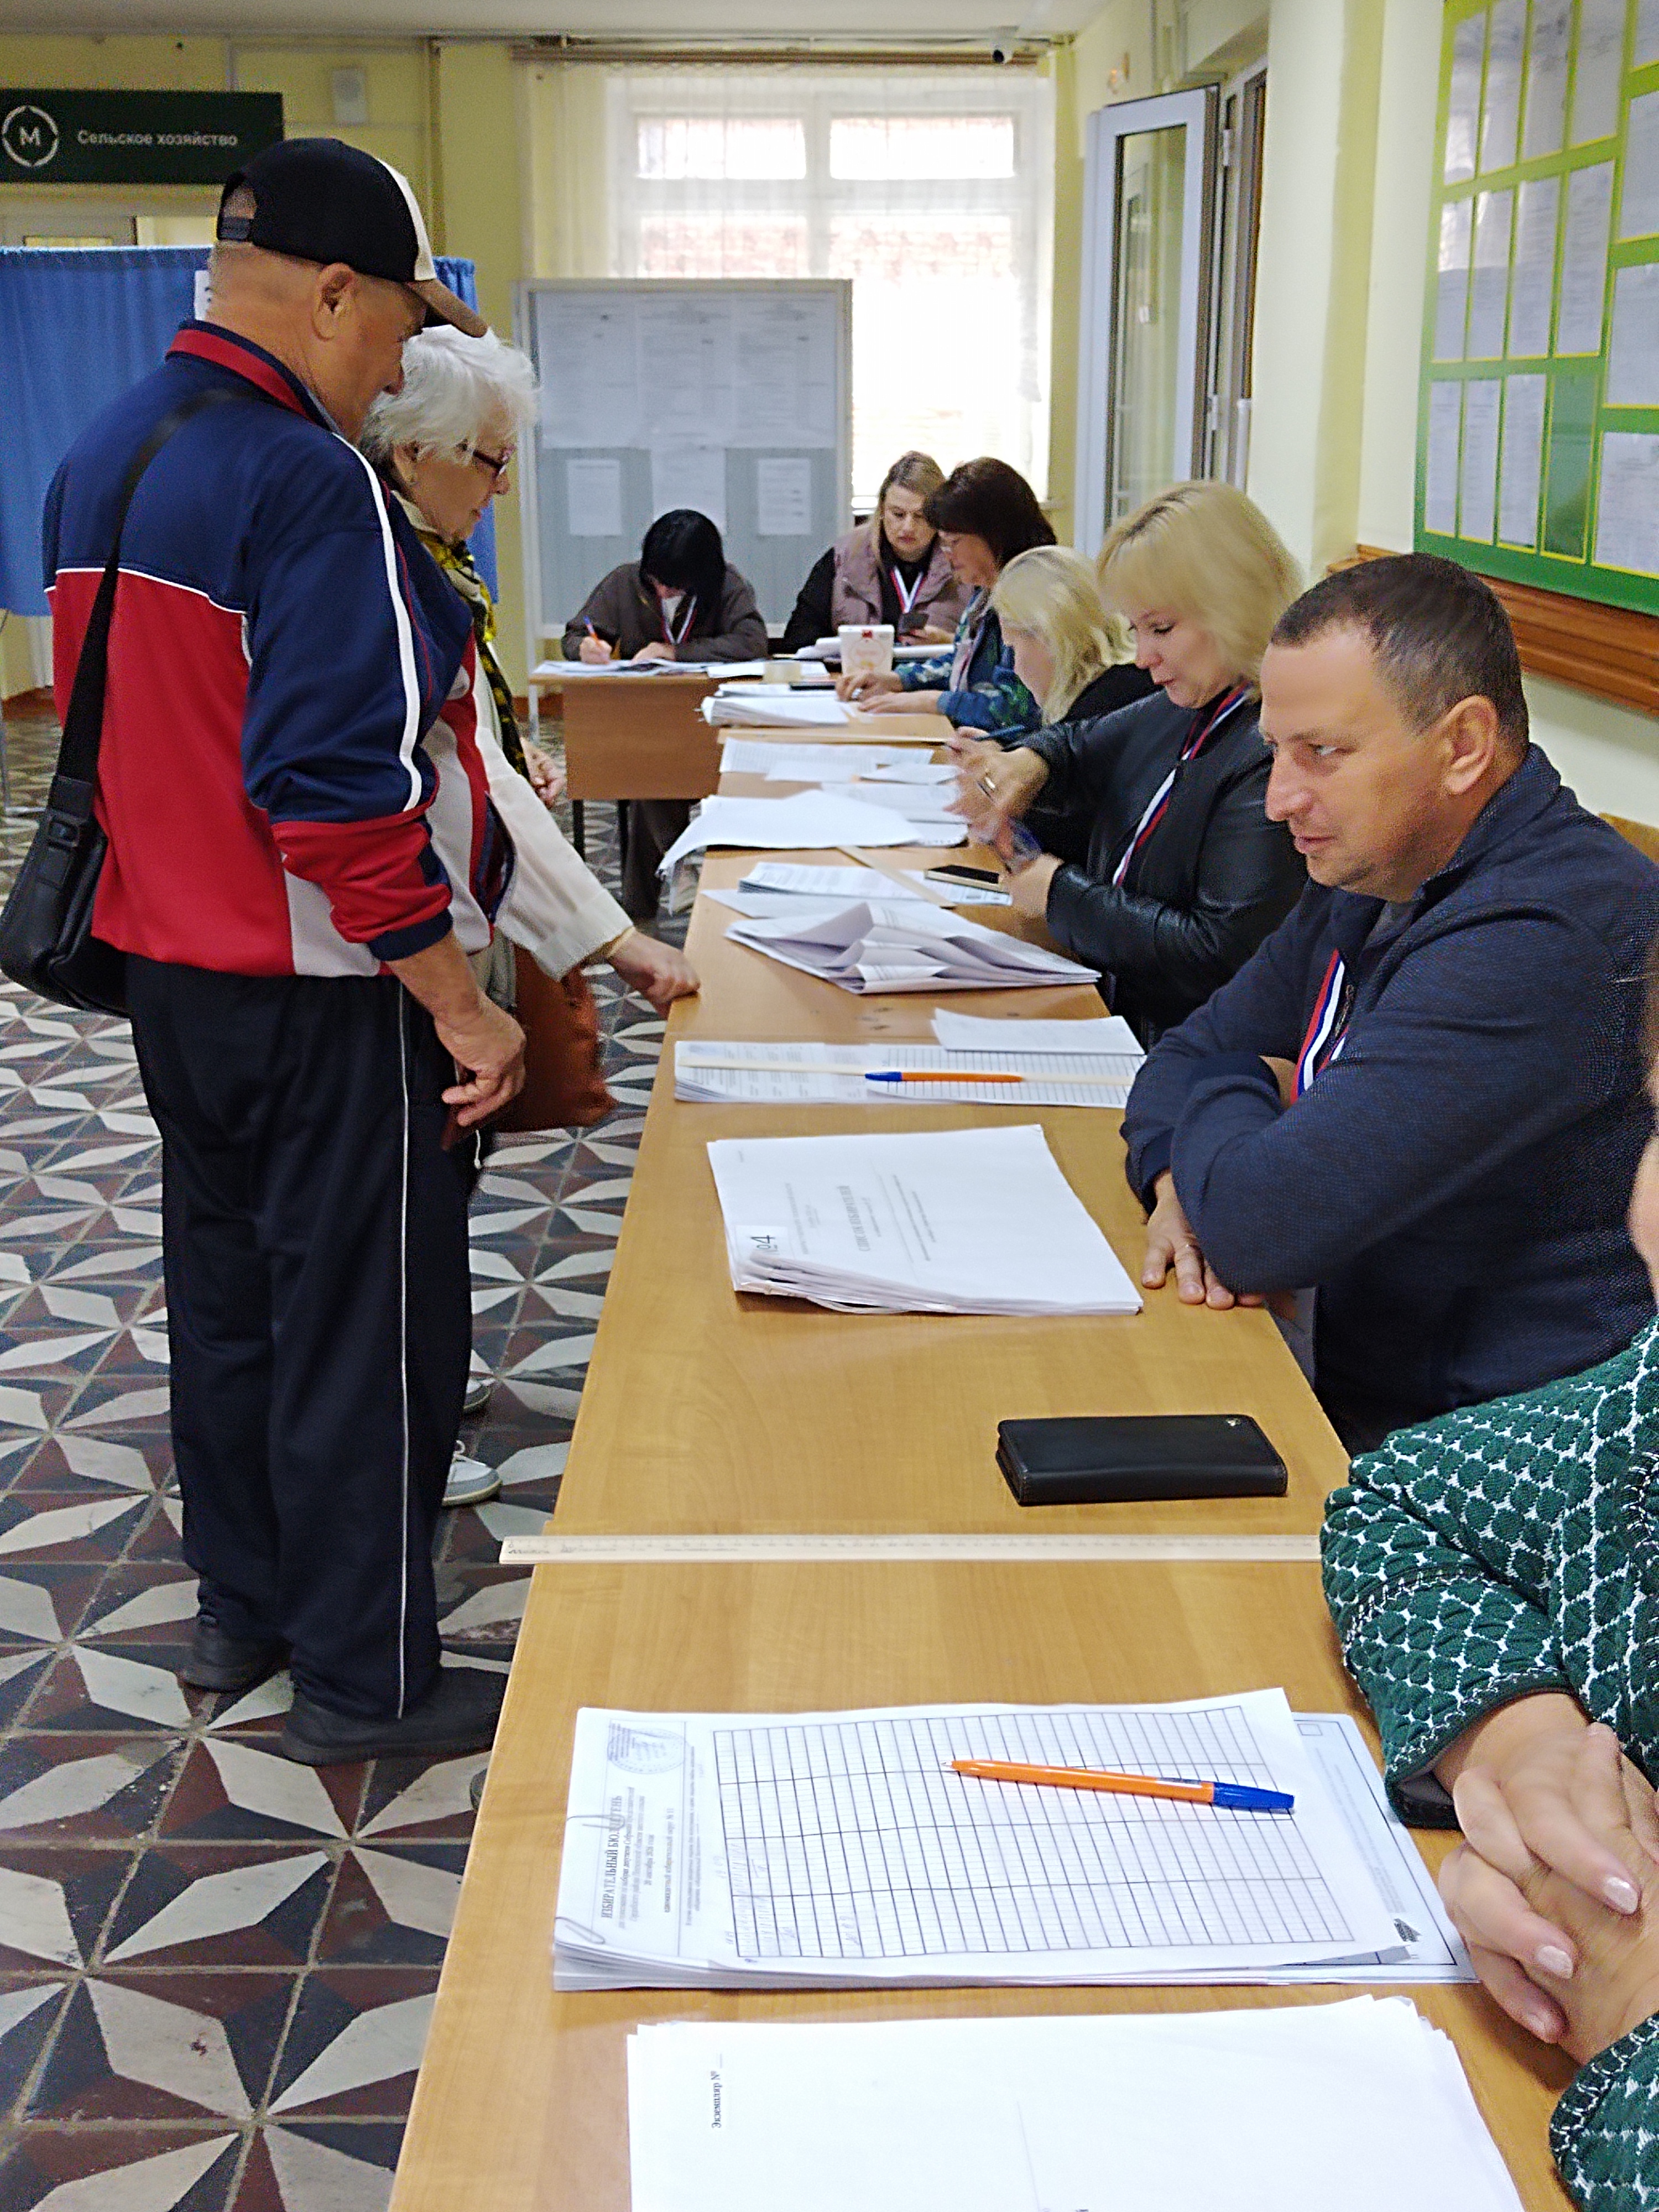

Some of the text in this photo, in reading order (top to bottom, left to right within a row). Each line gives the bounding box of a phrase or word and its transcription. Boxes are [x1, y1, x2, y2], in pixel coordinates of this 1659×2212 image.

[77, 129, 238, 147] Сельское хозяйство
[851, 1225, 870, 1251] СПИСОК
[601, 1849, 618, 1918] ИЗБИРАТЕЛЬНЫЙ
[711, 2071, 723, 2128] Экземпляр №
